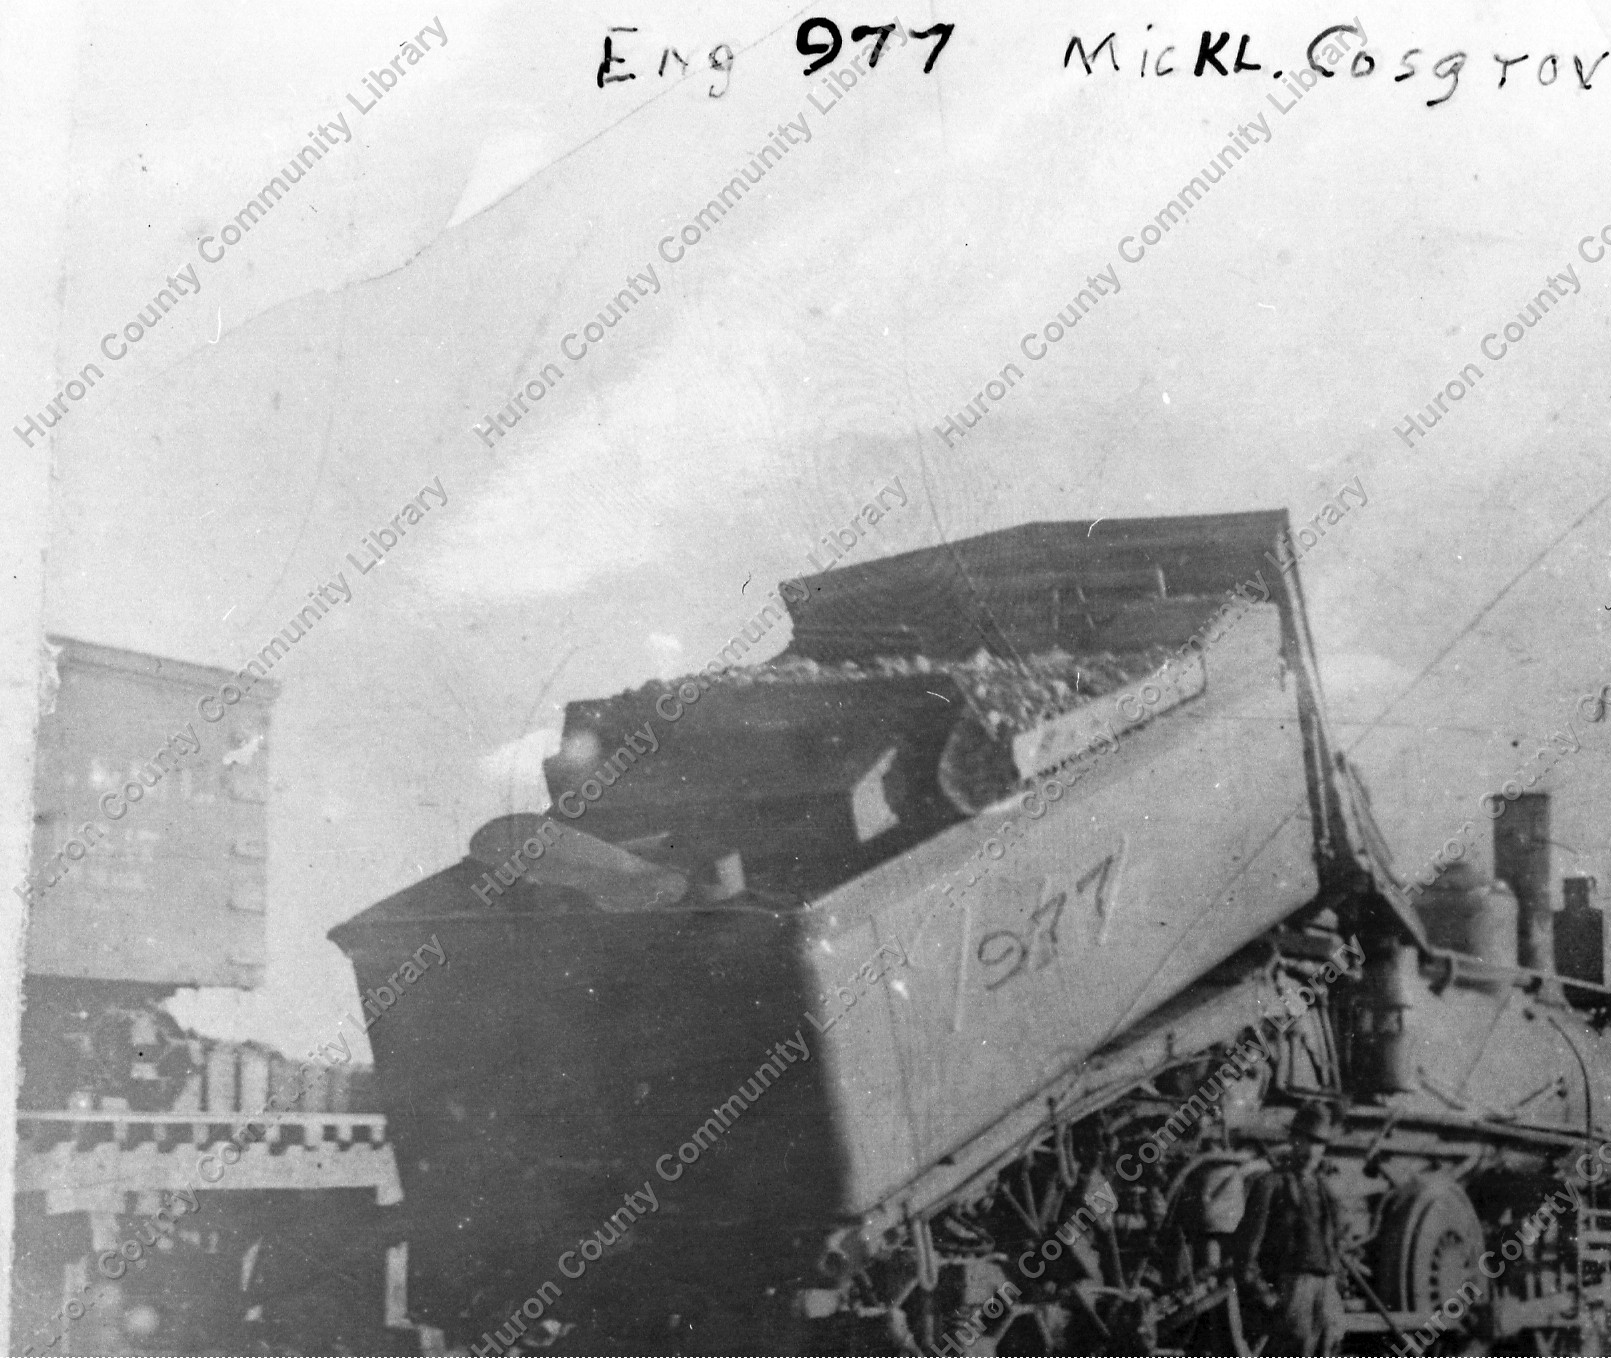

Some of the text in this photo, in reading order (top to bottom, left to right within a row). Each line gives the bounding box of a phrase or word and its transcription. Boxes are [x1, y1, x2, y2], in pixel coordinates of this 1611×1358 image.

[597, 26, 734, 98] Eng
[796, 17, 955, 76] 977
[976, 855, 1115, 992] 977
